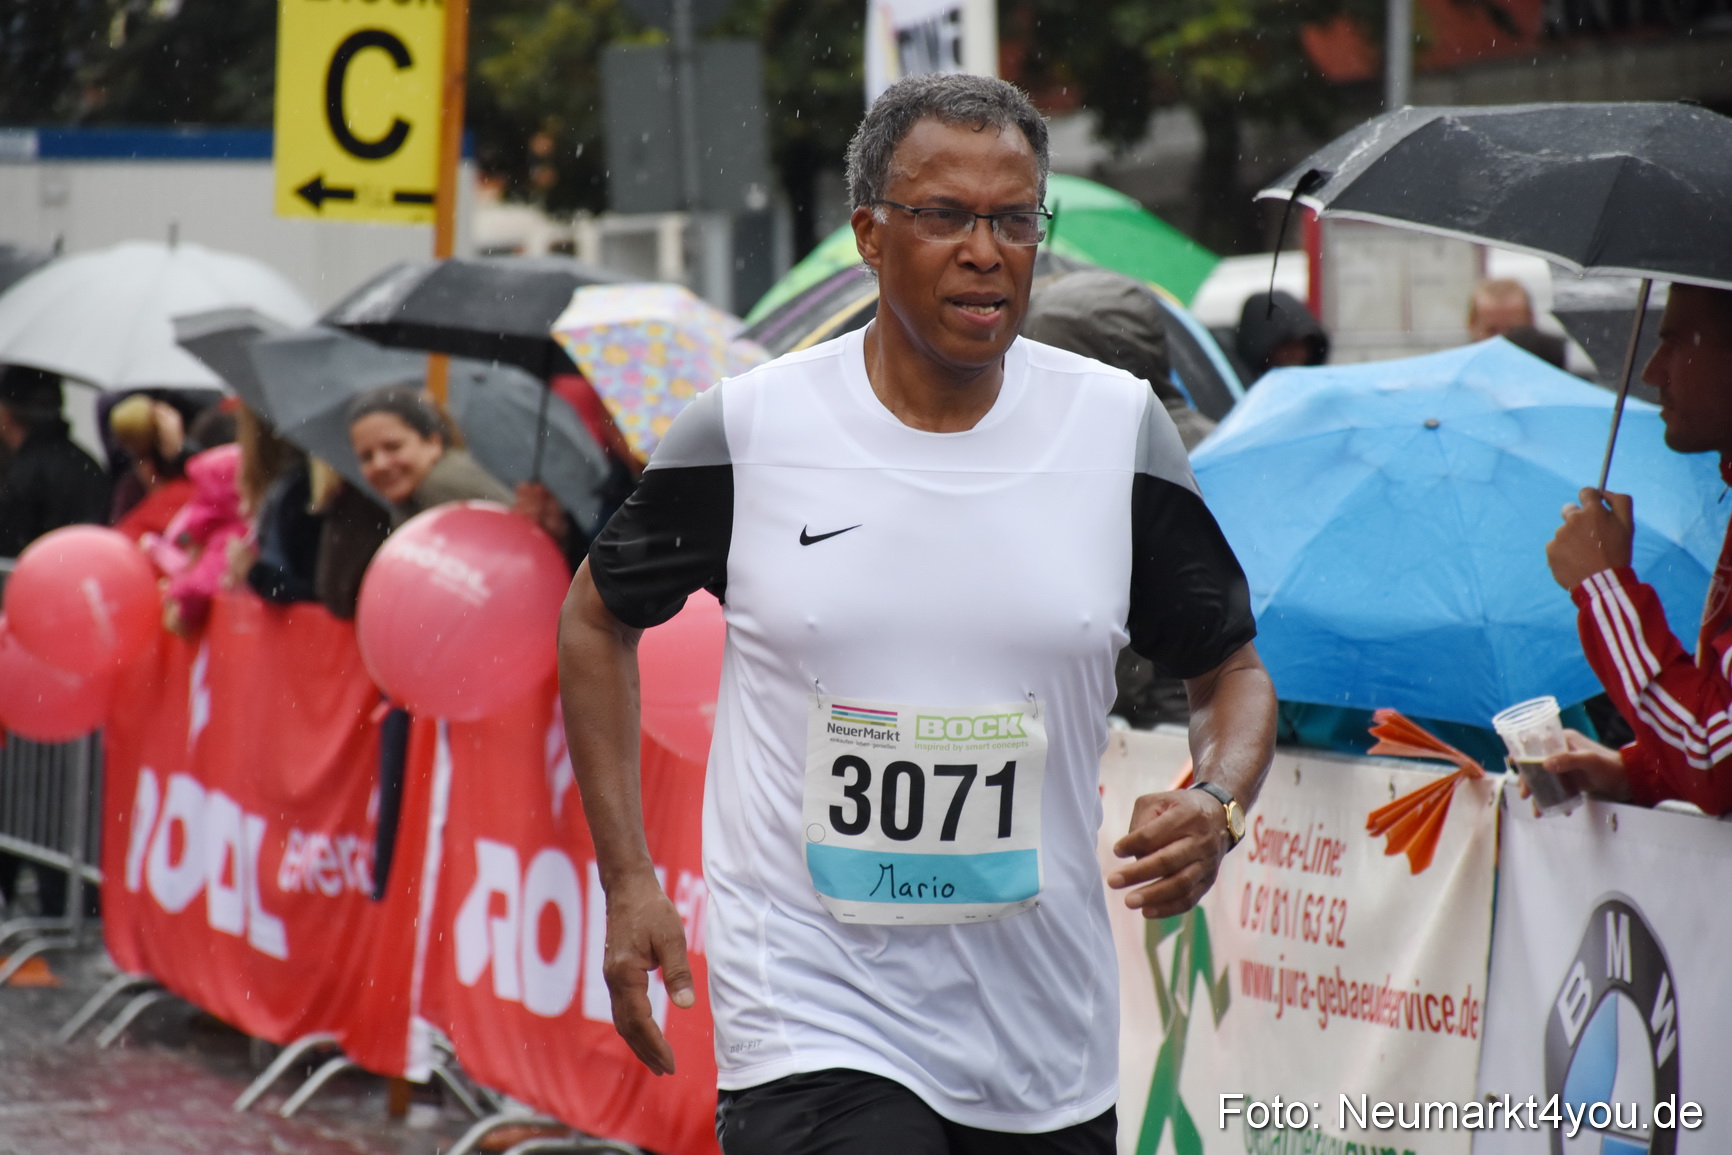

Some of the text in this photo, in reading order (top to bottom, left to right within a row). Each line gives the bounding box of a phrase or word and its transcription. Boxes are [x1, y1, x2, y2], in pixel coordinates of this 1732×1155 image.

[325, 28, 413, 161] C
[827, 722, 900, 742] NeuerMarkt
[915, 713, 1028, 741] BOCK
[915, 741, 1029, 752] inspired by smart concepts
[829, 755, 1016, 841] 3071
[870, 863, 955, 898] Mario
[1557, 911, 1677, 1070] BMW
